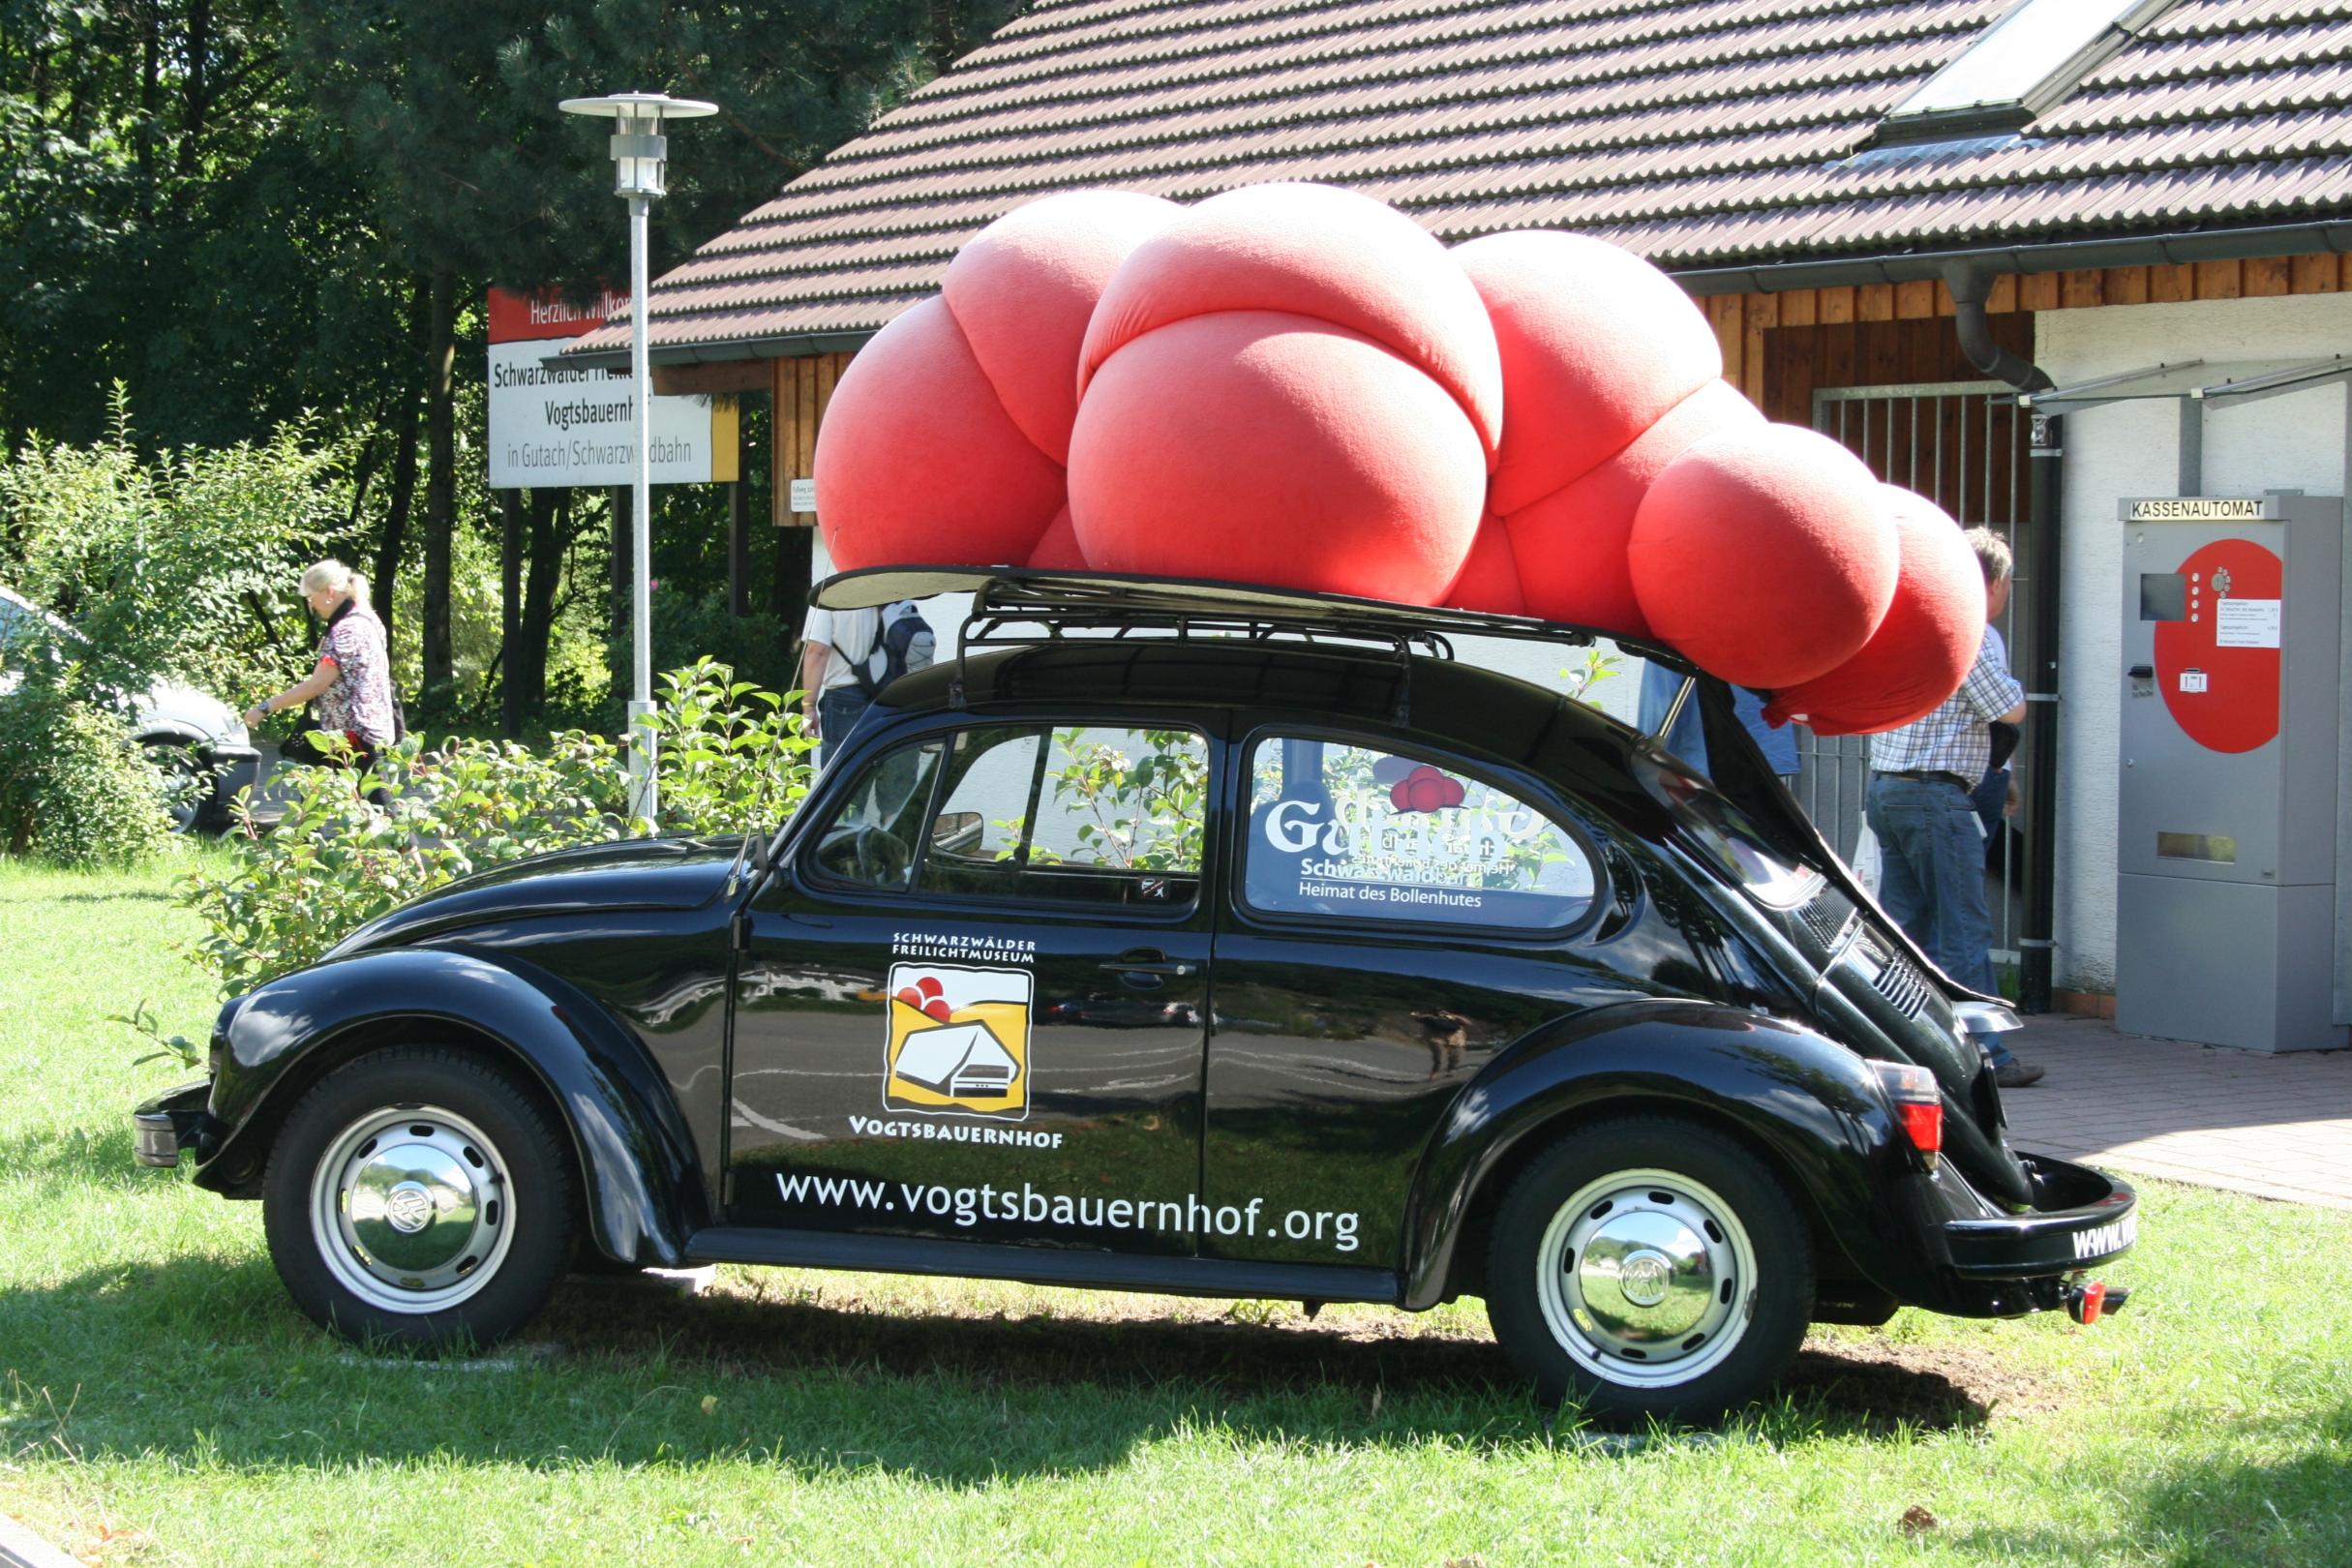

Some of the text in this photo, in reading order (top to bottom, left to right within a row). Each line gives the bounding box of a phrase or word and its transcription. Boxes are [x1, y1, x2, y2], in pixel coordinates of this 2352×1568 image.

[507, 436, 691, 471] in Gutach/Schwarzwdbahn
[2131, 500, 2264, 518] KASSENAUTOMAT
[1298, 882, 1482, 908] Heimat des Bollenhutes
[892, 932, 1036, 951] SCHWARZWÄLDER
[892, 944, 1035, 964] FREILICHTMUSEUM
[848, 1115, 1063, 1150] VOGTSBAUERNHOF
[776, 1173, 1359, 1251] www.vogtsbauernhof.org
